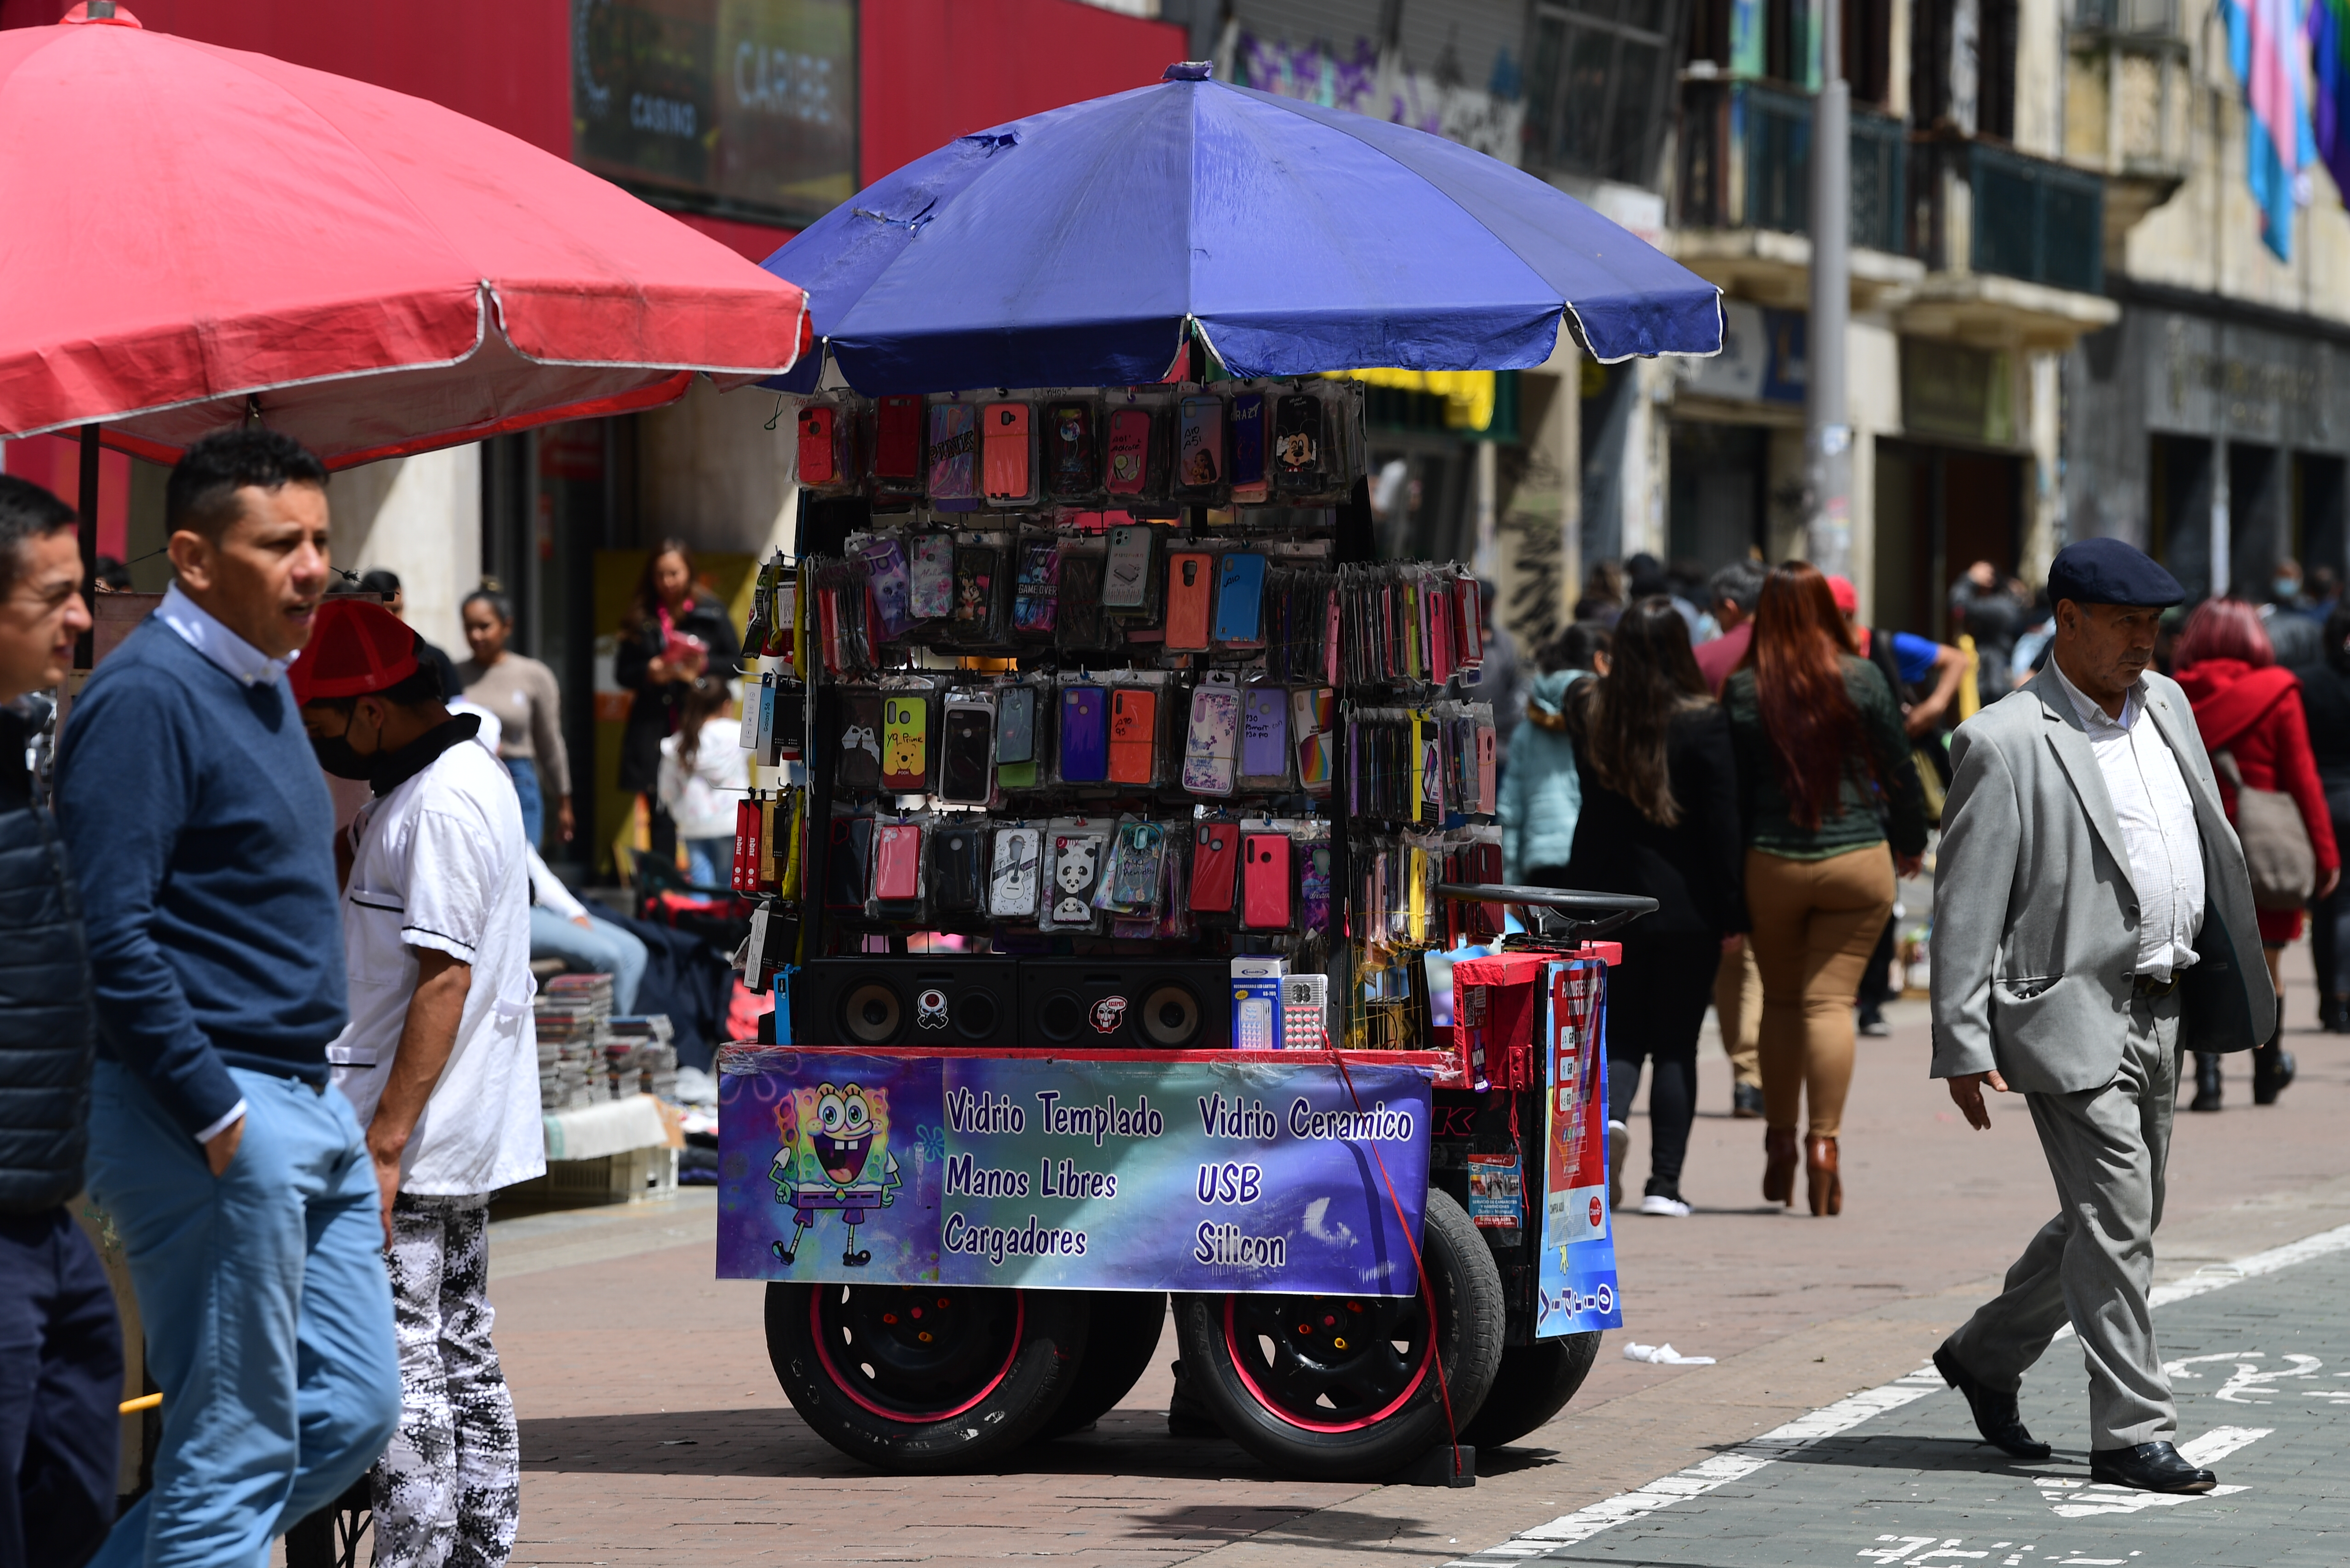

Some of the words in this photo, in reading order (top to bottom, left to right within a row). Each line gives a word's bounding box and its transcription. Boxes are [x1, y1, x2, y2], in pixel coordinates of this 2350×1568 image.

[929, 430, 974, 466] PINK
[1018, 584, 1037, 595] GAME
[1039, 585, 1058, 596] OVER
[765, 702, 770, 711] S6
[1472, 1048, 1485, 1068] WOM
[946, 1086, 1026, 1135] Vidrio
[1035, 1090, 1164, 1148] Templado
[1197, 1092, 1278, 1140] Vidrio
[1289, 1096, 1414, 1142] Ceramico
[945, 1152, 1030, 1198] Manos
[1040, 1157, 1118, 1200] Libres
[1196, 1160, 1263, 1206] USB
[944, 1211, 1087, 1267] Cargadores
[1194, 1219, 1286, 1267] Silicon
